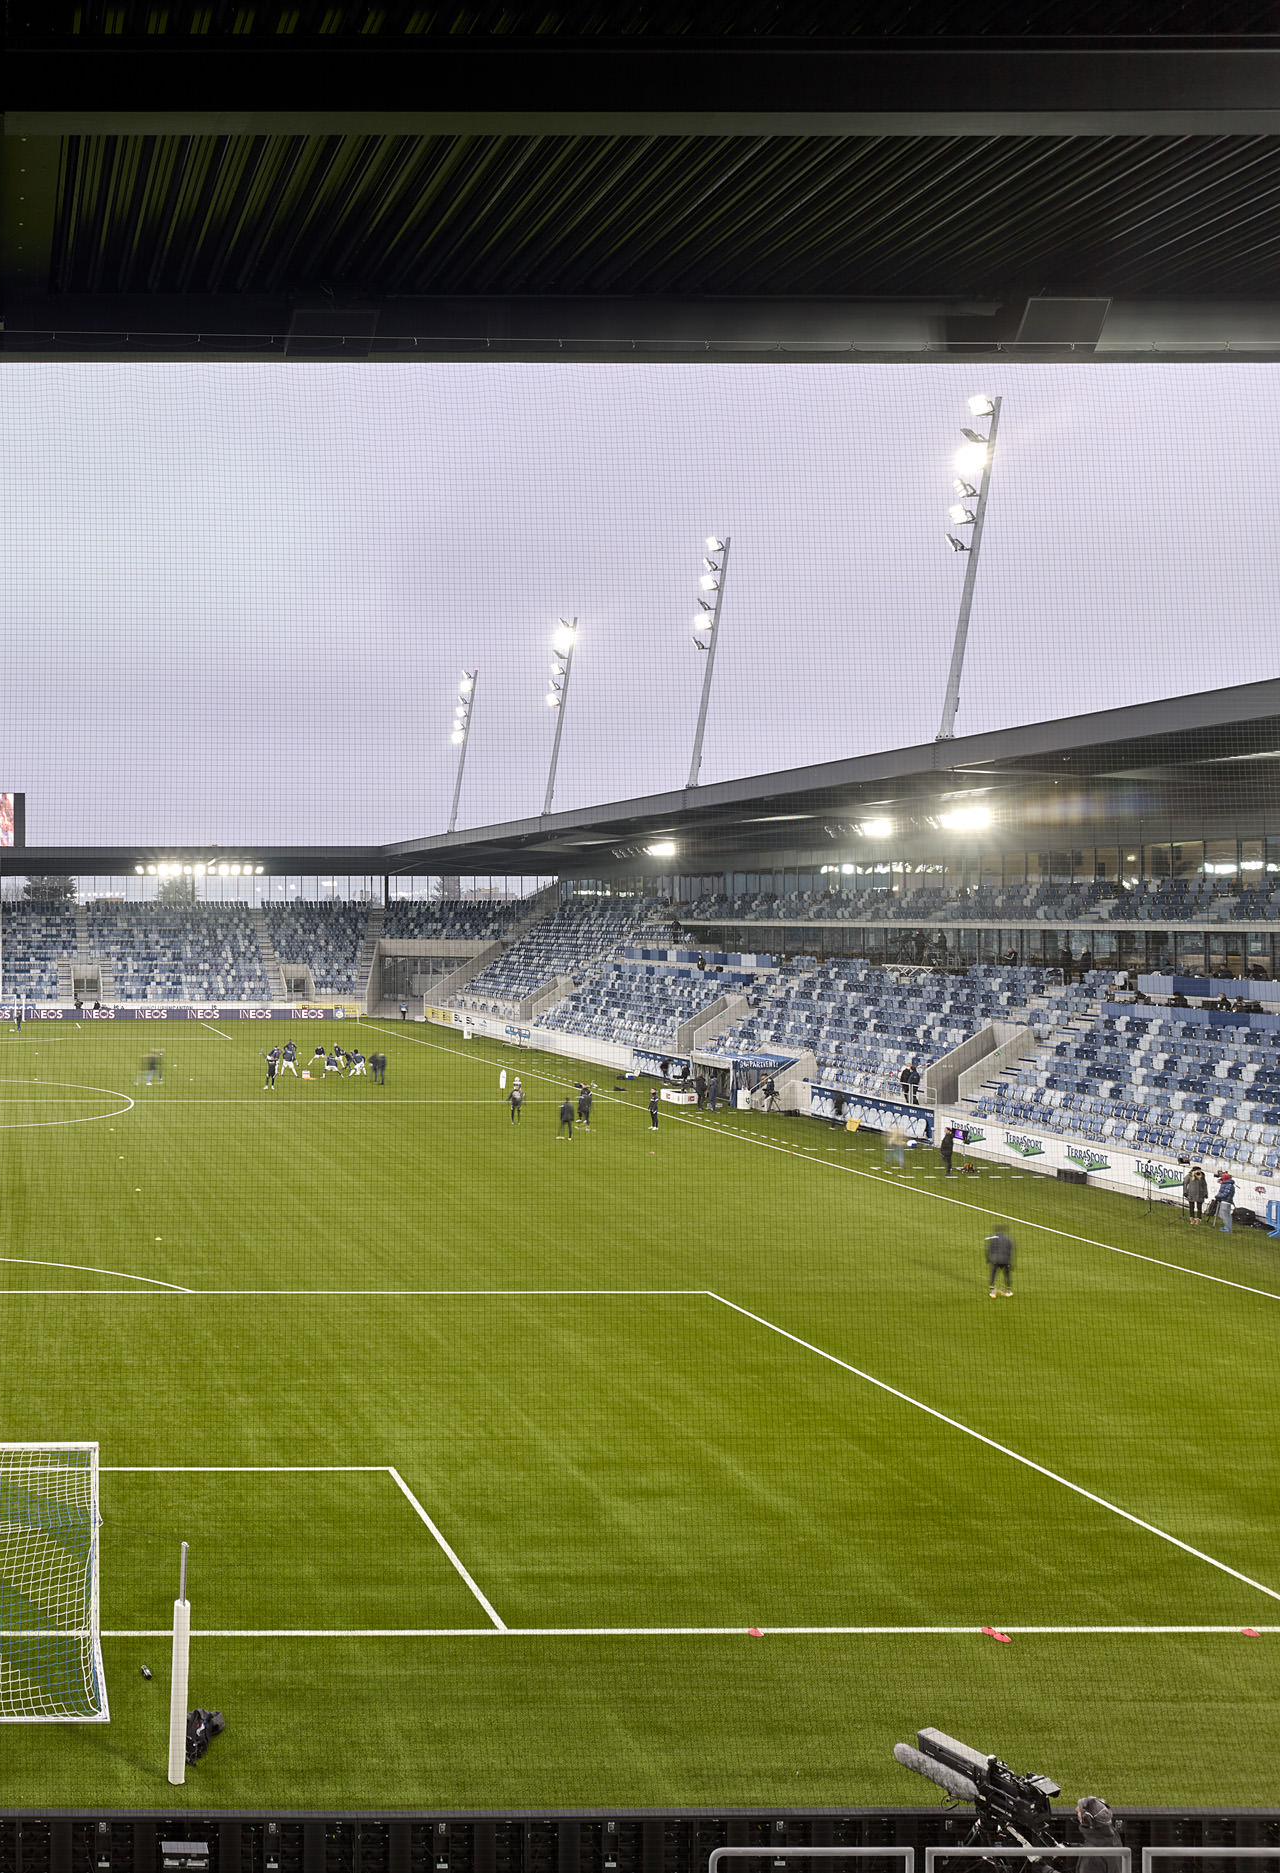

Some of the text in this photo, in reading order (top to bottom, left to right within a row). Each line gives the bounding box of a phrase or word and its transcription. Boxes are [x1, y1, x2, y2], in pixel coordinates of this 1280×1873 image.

[30, 1009, 63, 1019] INEOS
[82, 1009, 115, 1019] INEOS
[135, 1009, 168, 1019] INEOS
[187, 1009, 220, 1019] INEOS
[239, 1009, 272, 1019] INEOS
[291, 1009, 324, 1019] INEOS
[1005, 1131, 1043, 1151] TERRASPORT
[1066, 1144, 1109, 1166] TERRASPORT
